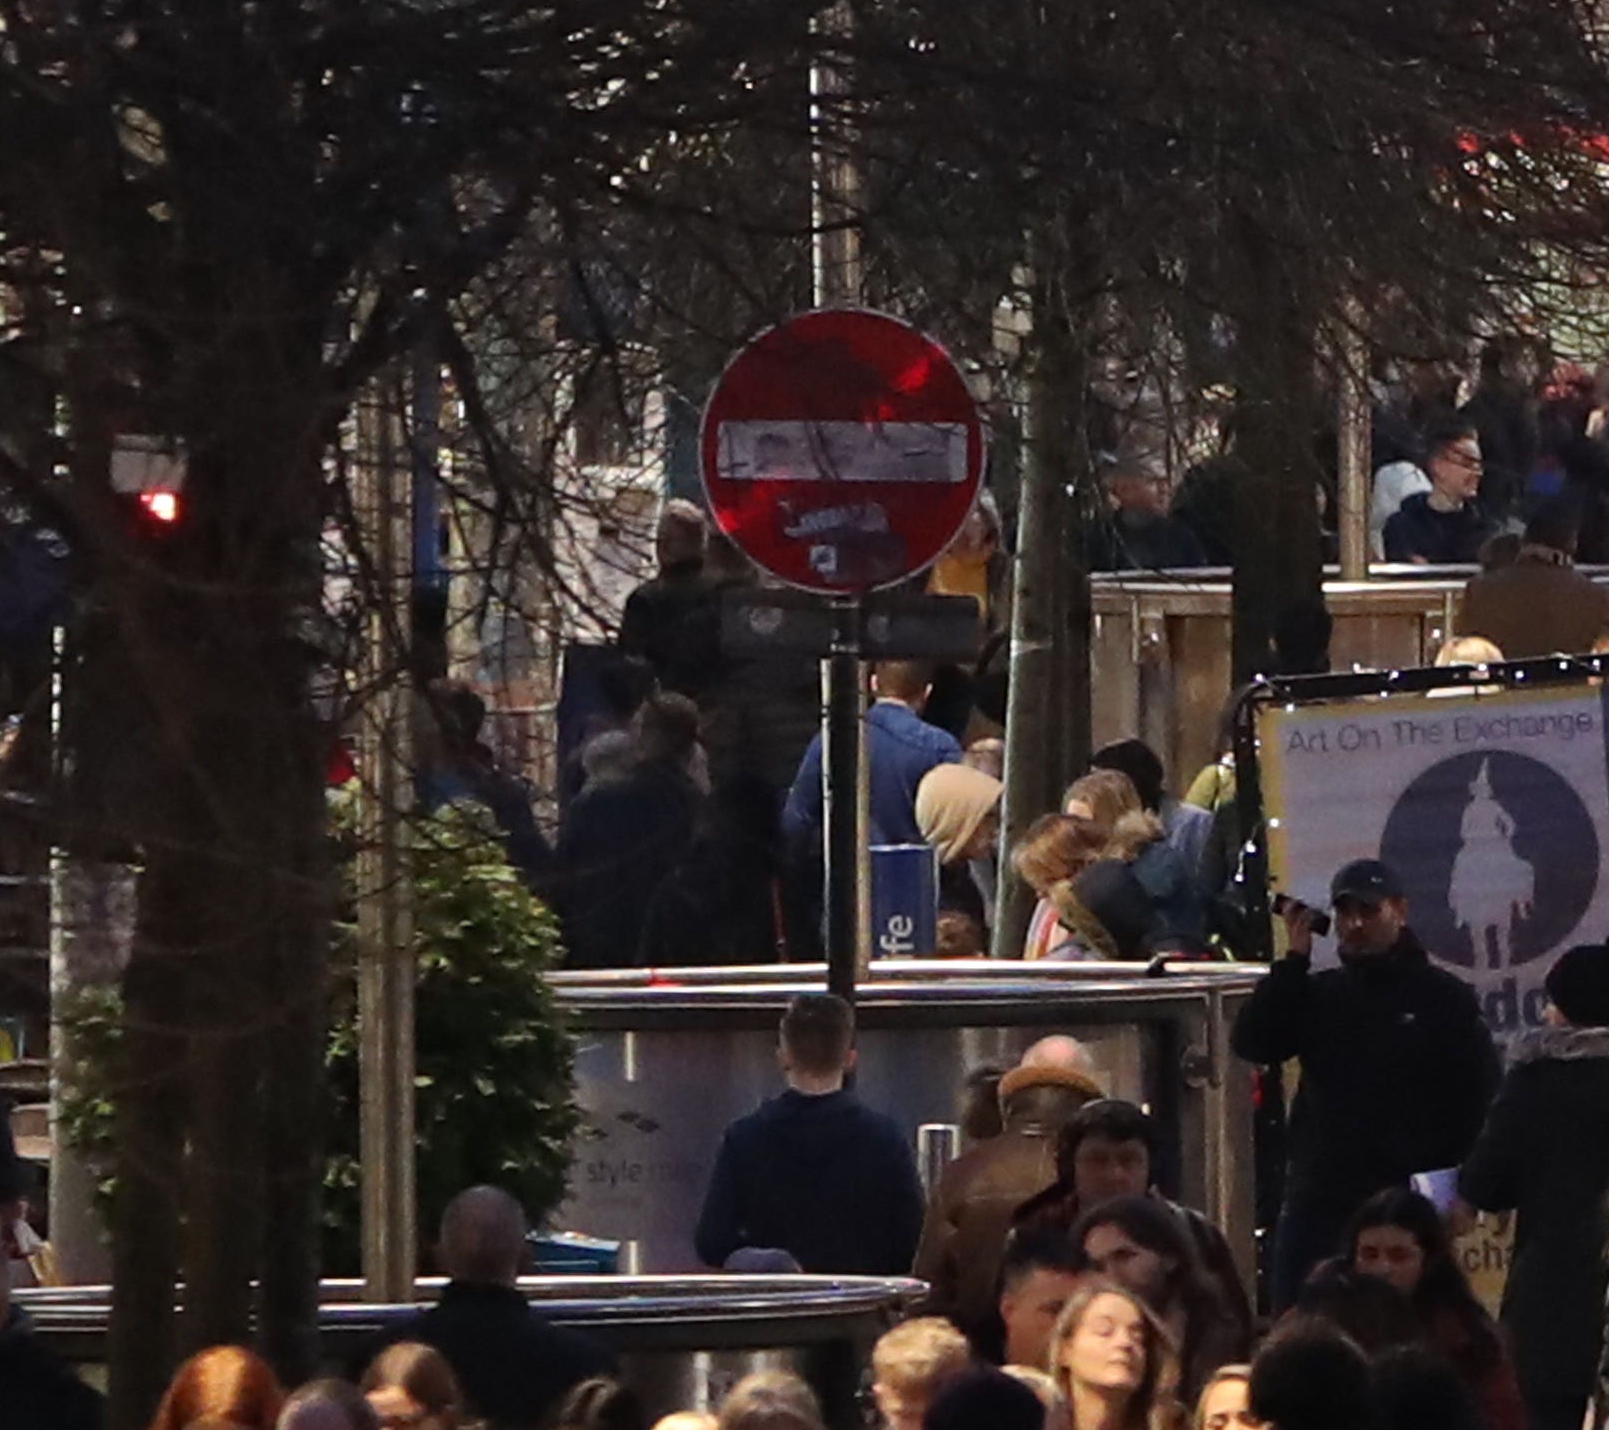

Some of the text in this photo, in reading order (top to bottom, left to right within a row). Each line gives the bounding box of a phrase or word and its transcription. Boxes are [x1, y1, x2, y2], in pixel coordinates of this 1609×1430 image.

[1286, 711, 1594, 754] Art On The Exchange
